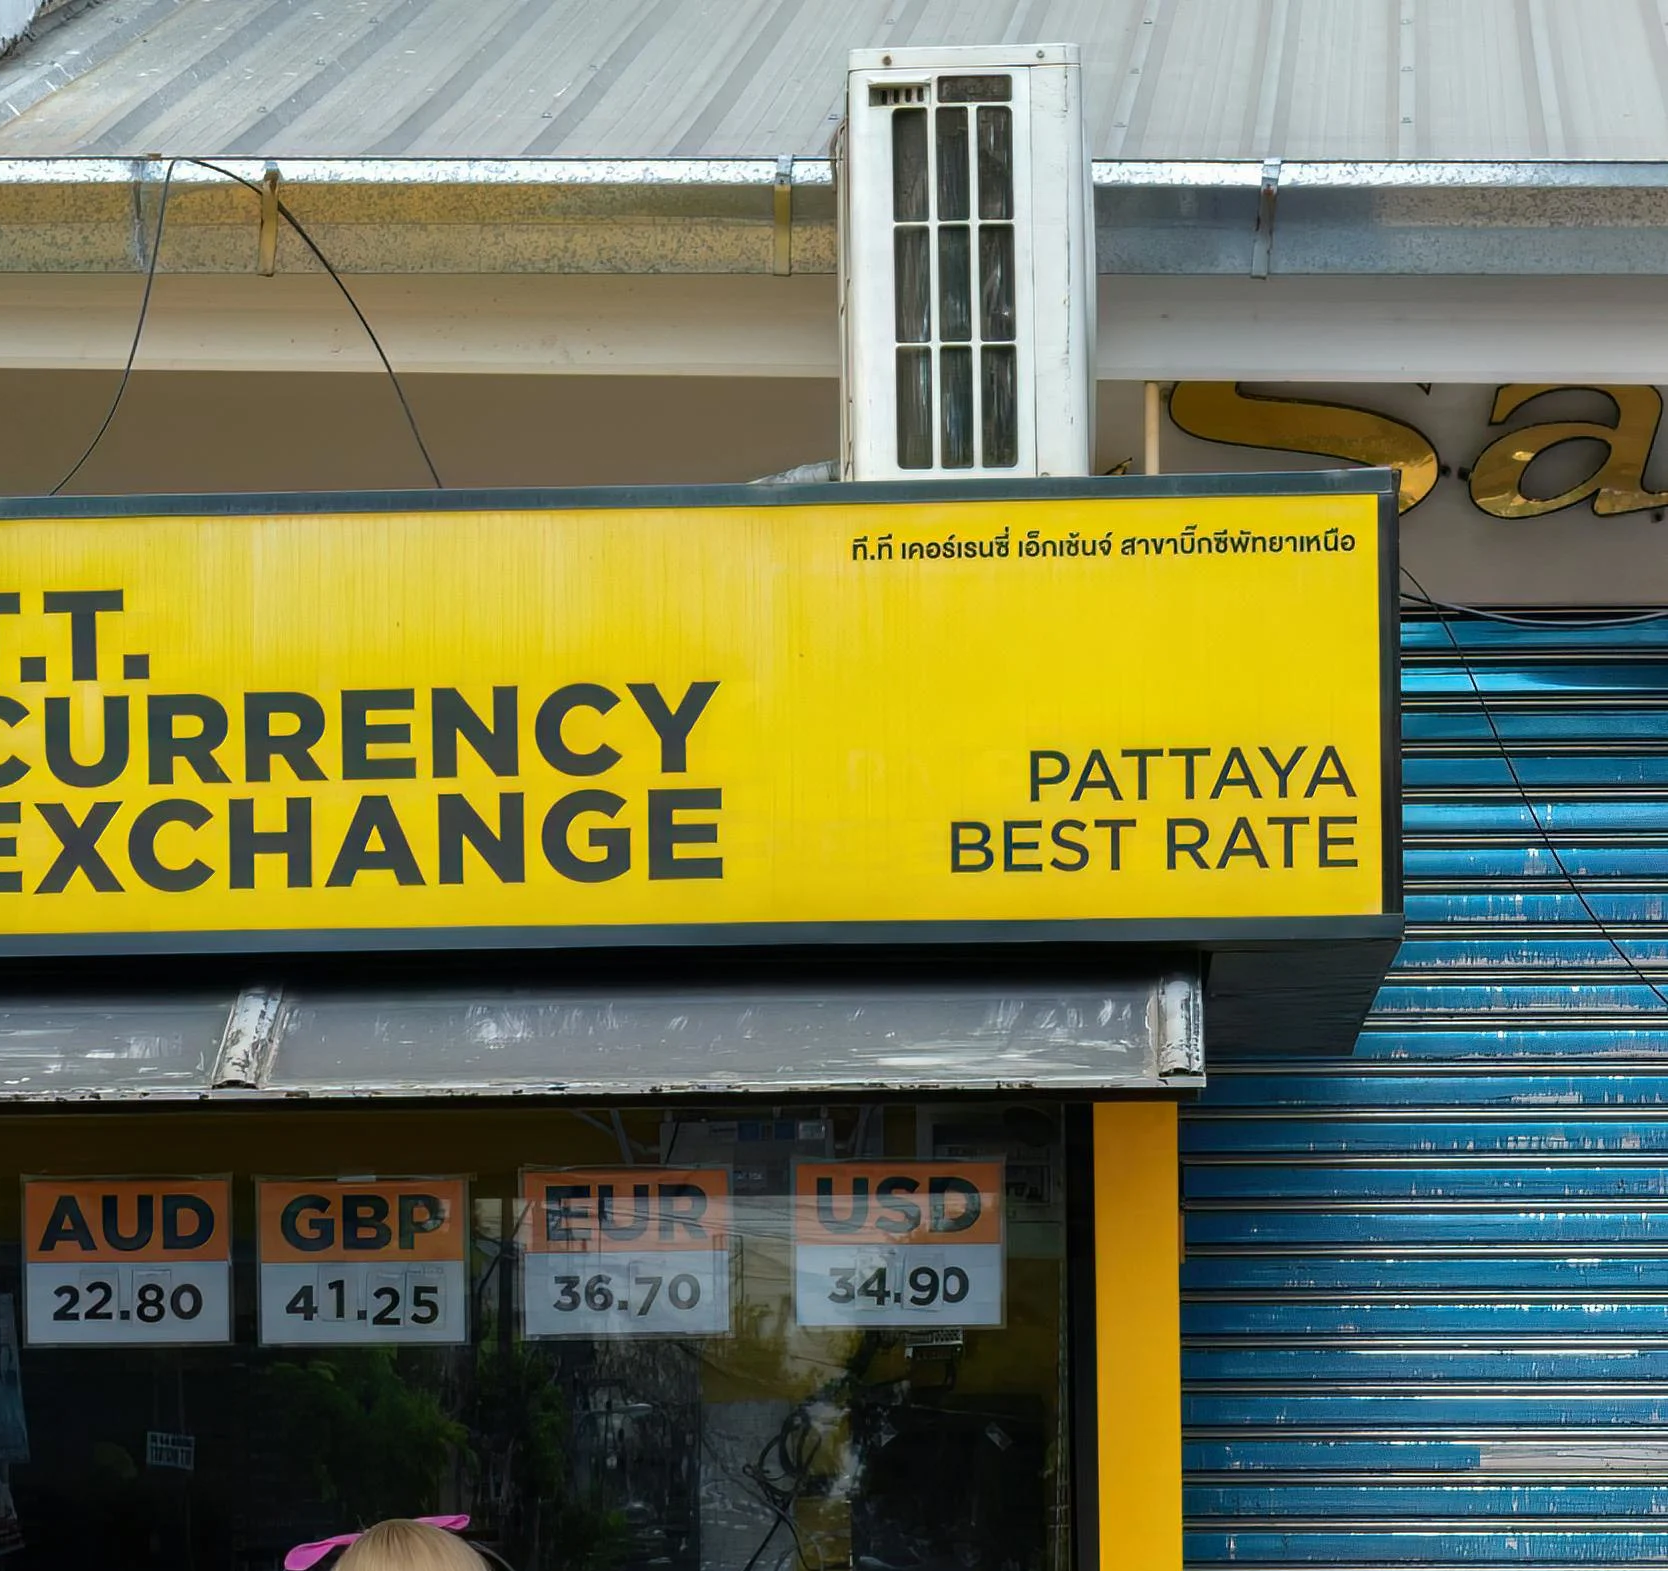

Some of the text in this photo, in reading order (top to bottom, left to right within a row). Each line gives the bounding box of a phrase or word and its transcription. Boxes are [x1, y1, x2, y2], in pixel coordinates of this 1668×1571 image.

[1029, 745, 1358, 803] PATTAYA
[950, 815, 1359, 874] BEST RATE
[37, 1193, 215, 1252] AUD
[280, 1193, 445, 1252] GBP
[545, 1183, 707, 1242] EUR
[815, 1175, 982, 1235] USD
[53, 1281, 204, 1323] 22.80
[285, 1279, 440, 1326] 41.25
[553, 1273, 701, 1317] 36.70
[826, 1265, 970, 1306] 34.90
